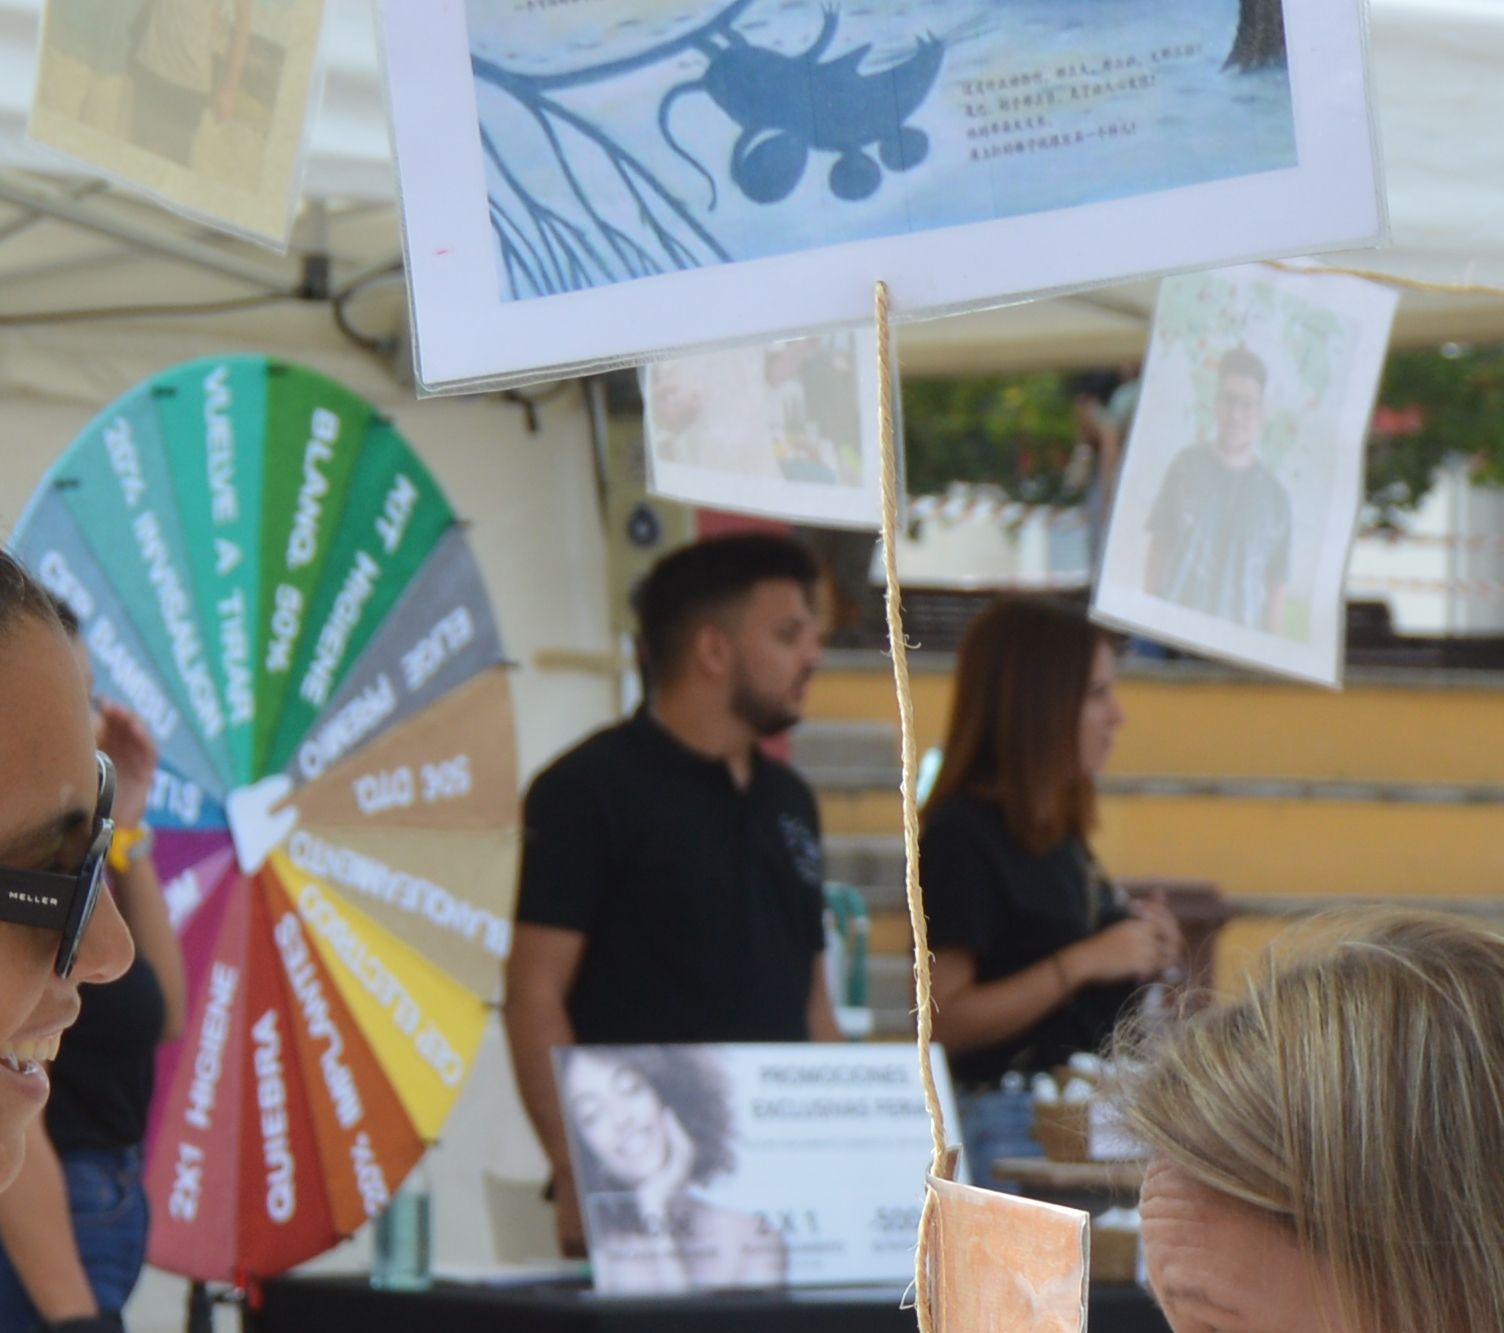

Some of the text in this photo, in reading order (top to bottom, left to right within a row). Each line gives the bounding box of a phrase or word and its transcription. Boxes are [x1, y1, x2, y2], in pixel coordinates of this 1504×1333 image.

[202, 364, 255, 727] VUELVE A TIRAR
[298, 473, 419, 708] KIT HIGIENE
[299, 606, 474, 780] ELIGE PREMIO
[9, 891, 58, 906] MELLER
[288, 829, 513, 960] BLANQUEAMIENTO
[186, 961, 241, 1130] HIGIENE
[250, 1009, 295, 1224] QUIEBRA
[274, 912, 363, 1130] IMPLANTES
